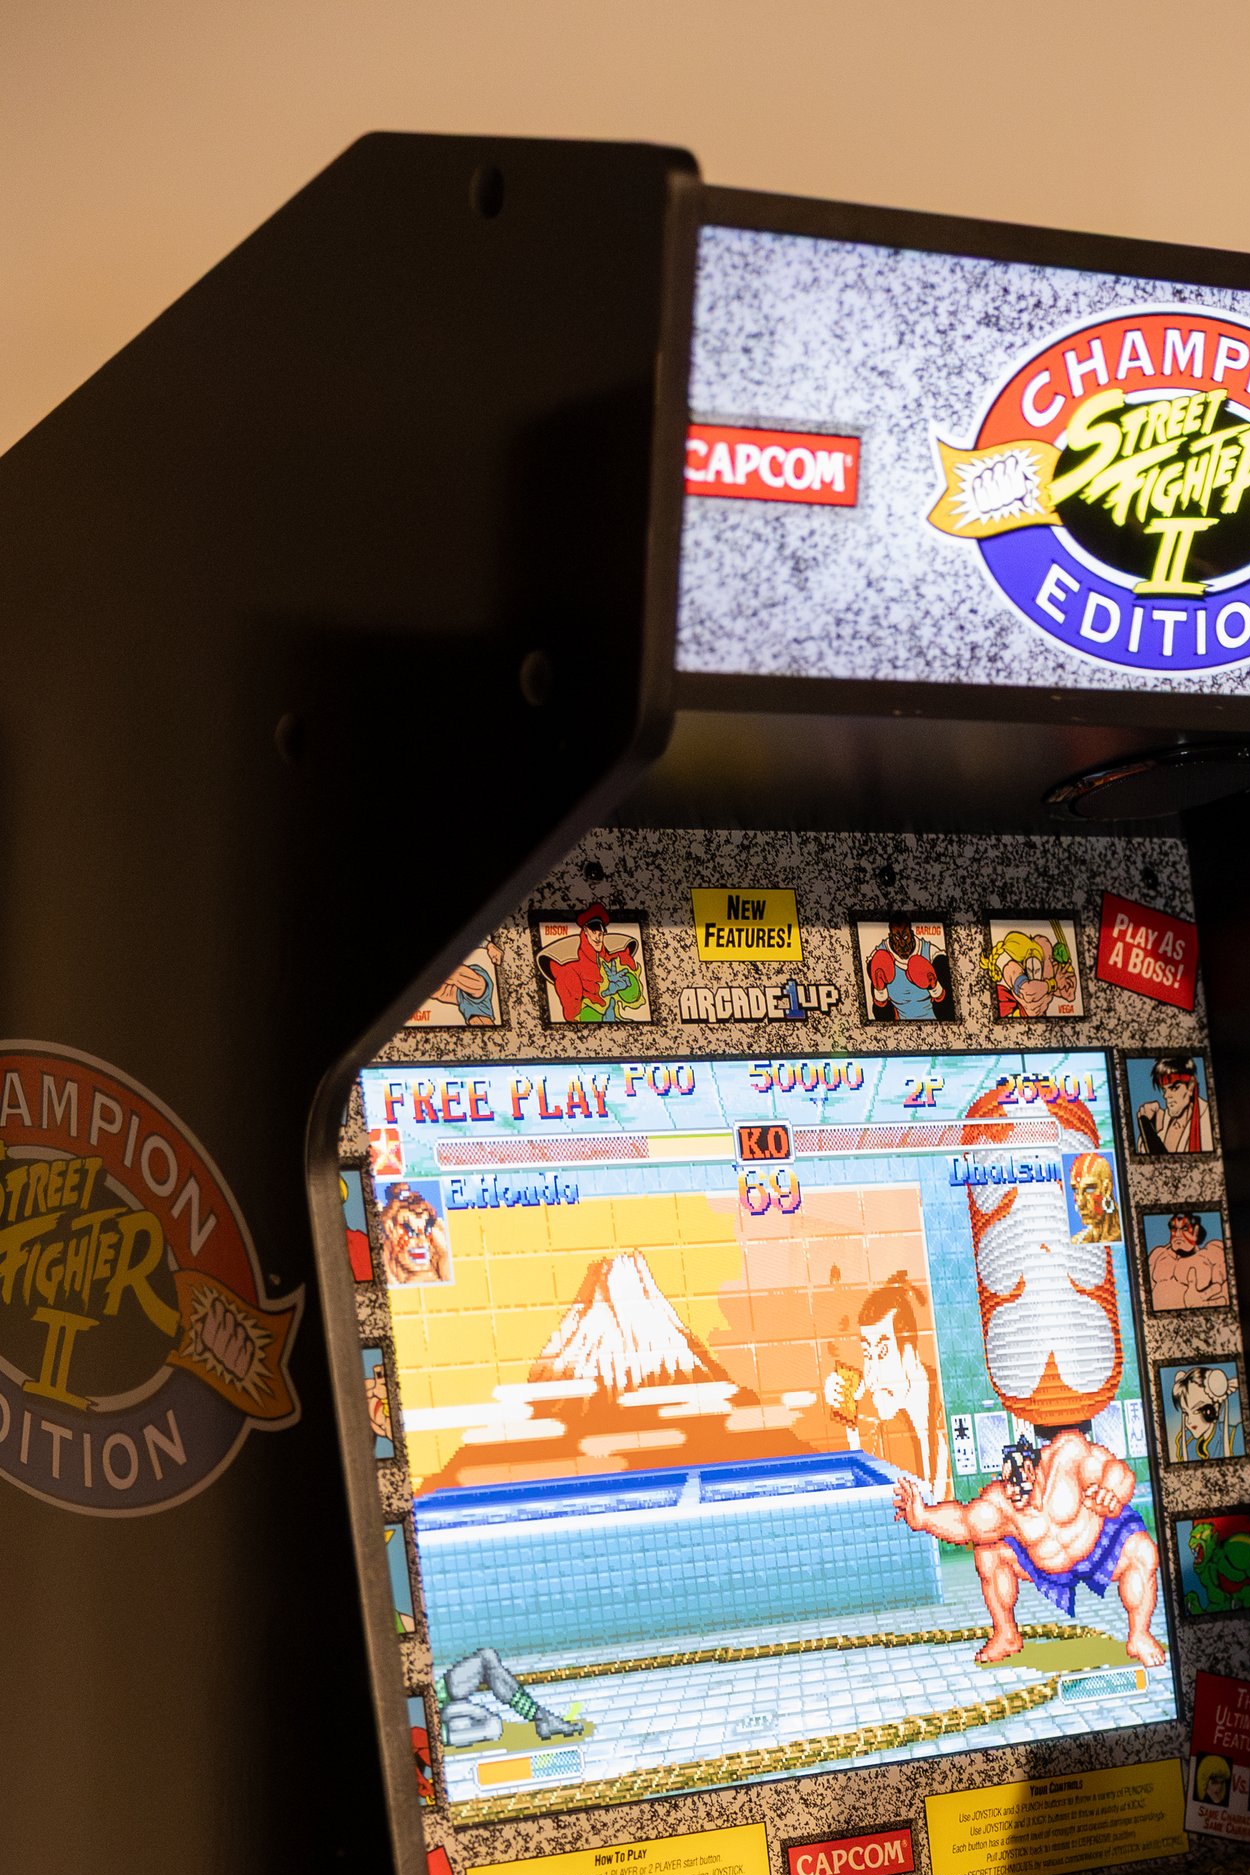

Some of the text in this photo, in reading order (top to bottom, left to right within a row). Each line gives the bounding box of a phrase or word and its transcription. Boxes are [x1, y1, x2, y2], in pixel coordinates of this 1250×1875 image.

[1048, 388, 1229, 506] STREET
[1132, 517, 1220, 596] II
[727, 894, 766, 921] NEW
[544, 925, 569, 936] BISON
[704, 922, 793, 949] FEATURES!
[915, 925, 942, 936] BARLOG
[1112, 912, 1186, 961] PLAY AS
[1108, 941, 1185, 990] A BOSS!
[680, 980, 840, 1020] ARCADE1UP
[1058, 1004, 1075, 1015] VEGA
[749, 1061, 864, 1093] 50000
[382, 1074, 611, 1124] FREE PLAY
[902, 1074, 945, 1108] 2P
[0, 1140, 102, 1222] TREET
[739, 1168, 802, 1216] 69
[0, 1408, 188, 1490] ITION
[957, 1810, 971, 1823] Use
[970, 1806, 1001, 1821] JOYSTICK
[969, 1824, 982, 1836] Use
[982, 1819, 1012, 1834] JOYSTICK
[594, 1847, 647, 1866] HOW TO PLAY
[951, 1842, 966, 1854] Each
[967, 1839, 987, 1851] button
[988, 1837, 999, 1847] has
[997, 1846, 1028, 1861] JOYSTICK
[653, 1858, 681, 1872] PLAYER
[683, 1856, 698, 1868] start
[699, 1852, 722, 1865] button.
[992, 1860, 1034, 1875] TECHNIQUES
